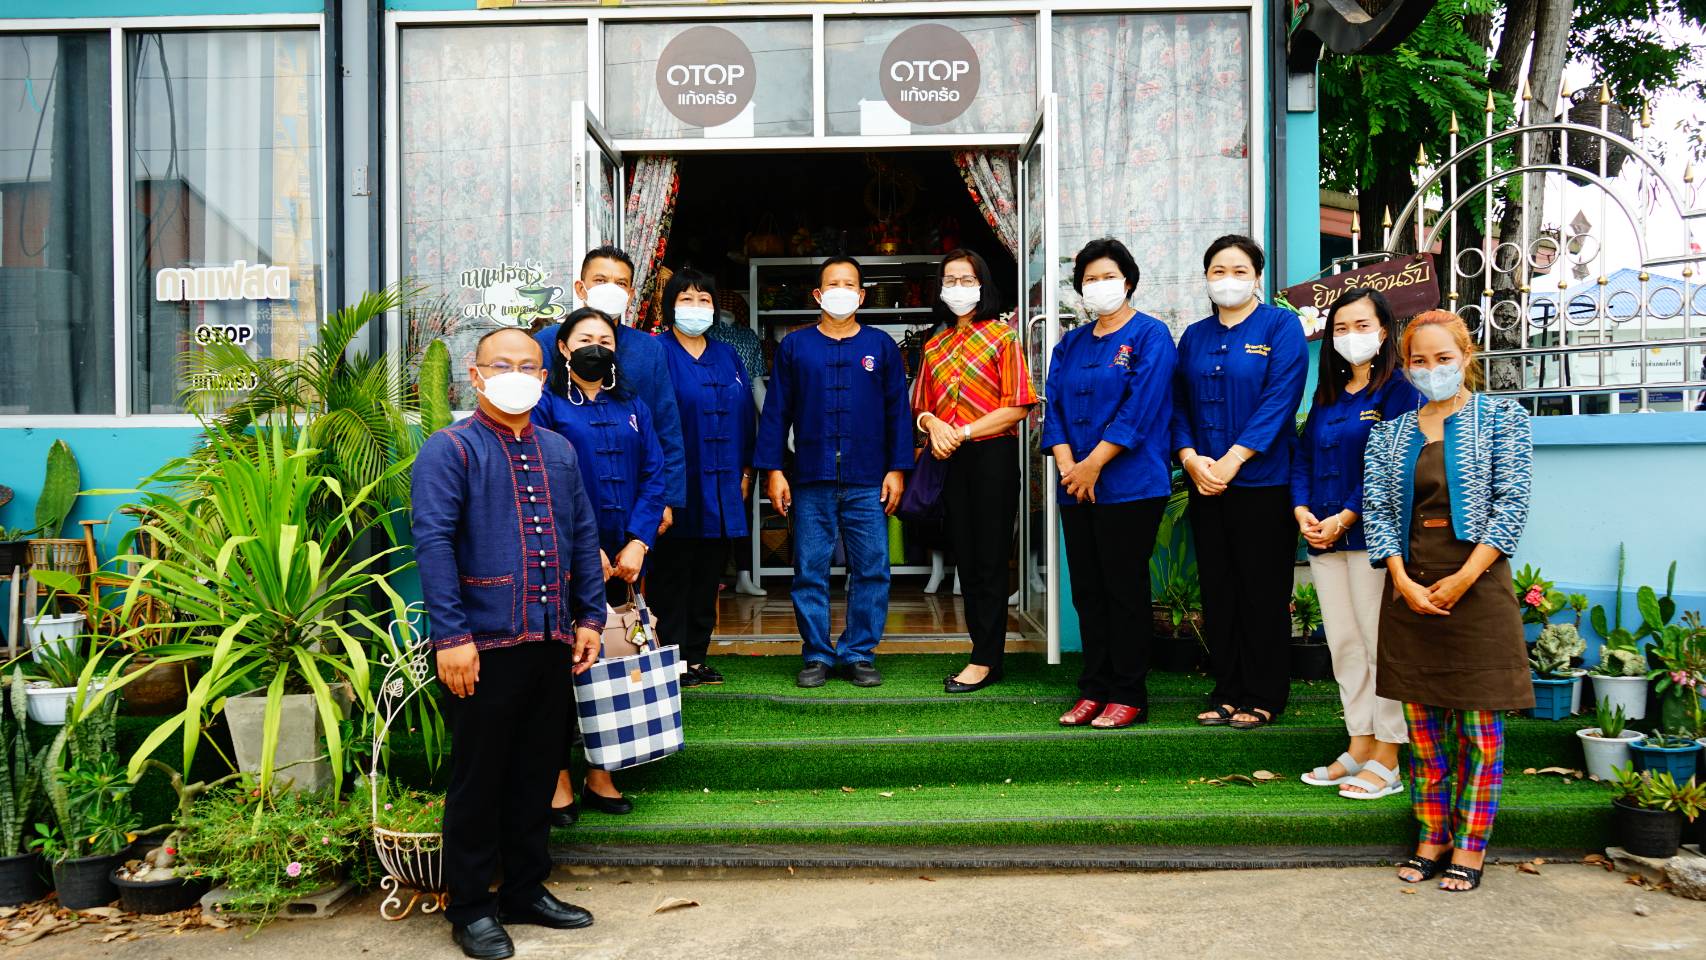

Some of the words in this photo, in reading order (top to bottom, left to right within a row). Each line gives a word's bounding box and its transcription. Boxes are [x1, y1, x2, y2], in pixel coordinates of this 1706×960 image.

[666, 63, 745, 86] OTOP
[890, 59, 970, 82] OTOP
[678, 89, 737, 105] แก้งคร้อ
[900, 86, 960, 102] แก้งคร้อ
[157, 261, 290, 300] กาแฟสด
[196, 325, 252, 345] OTOP
